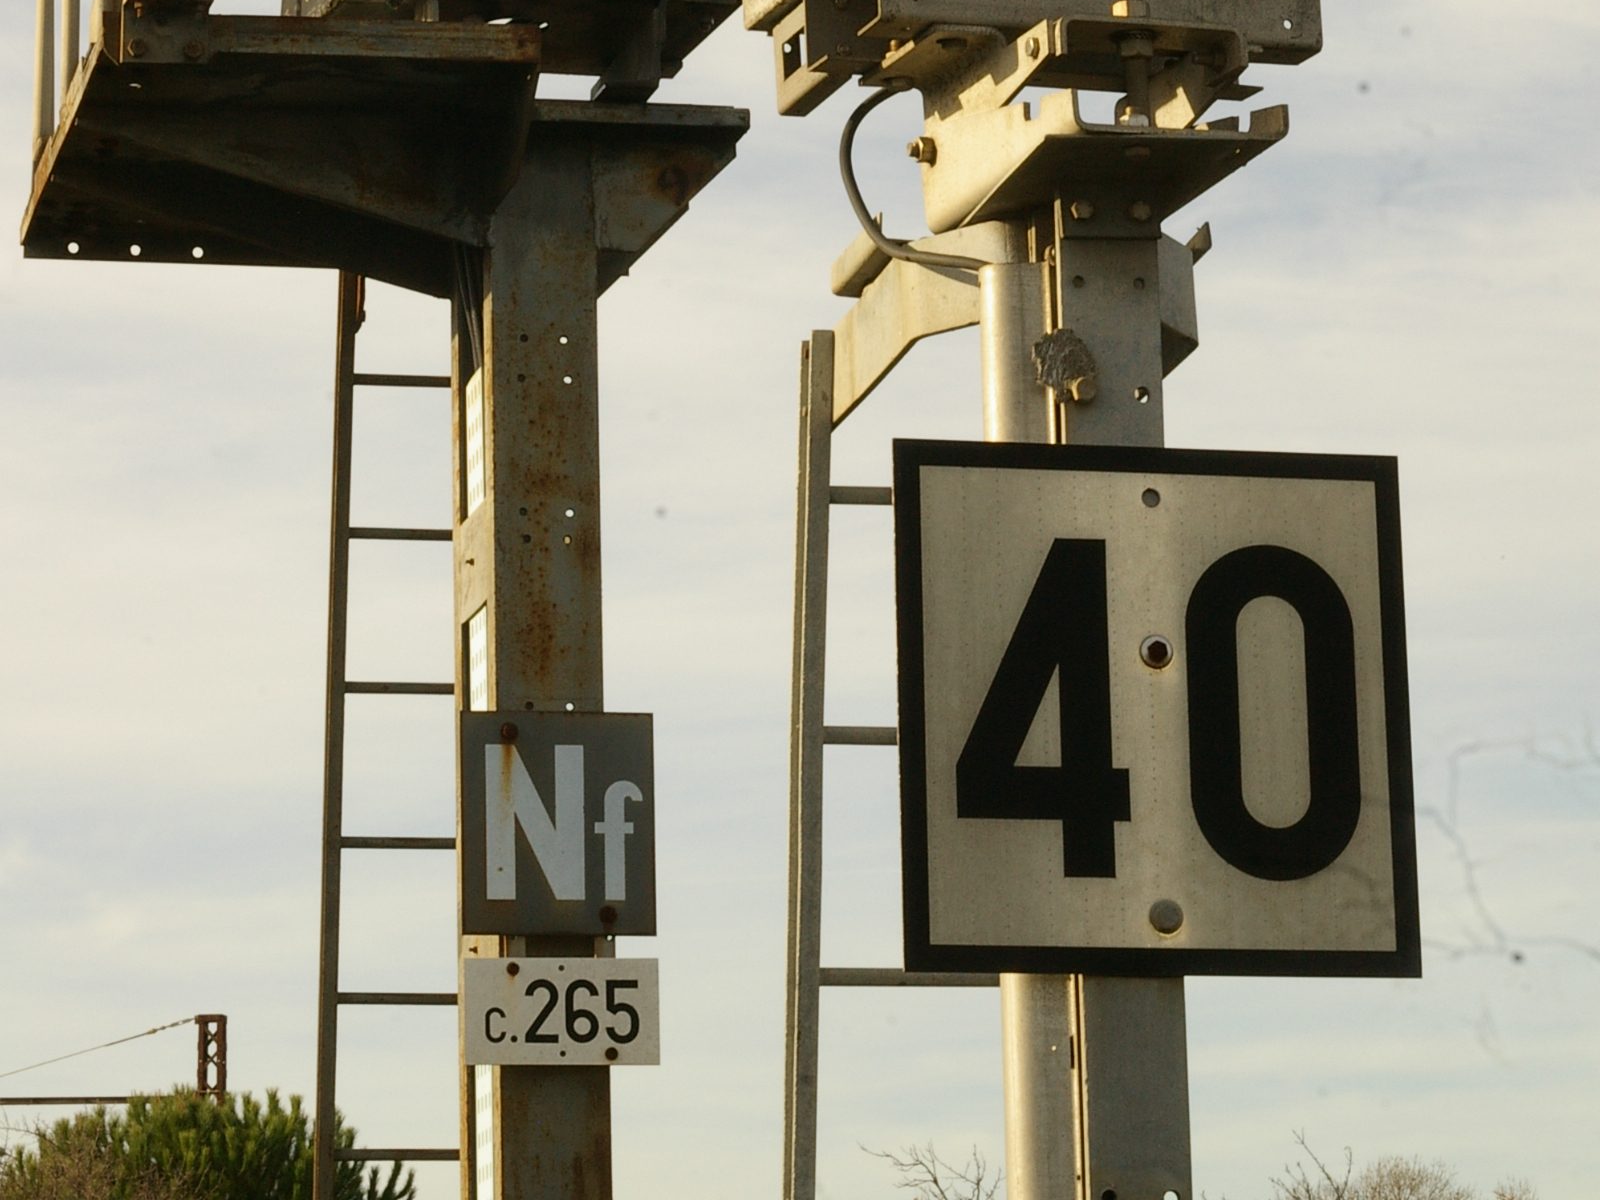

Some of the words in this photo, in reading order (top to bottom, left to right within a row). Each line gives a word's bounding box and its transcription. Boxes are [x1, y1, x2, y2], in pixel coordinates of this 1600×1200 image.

[955, 537, 1362, 882] 40
[484, 743, 643, 901] Nf
[484, 978, 640, 1044] c.265
